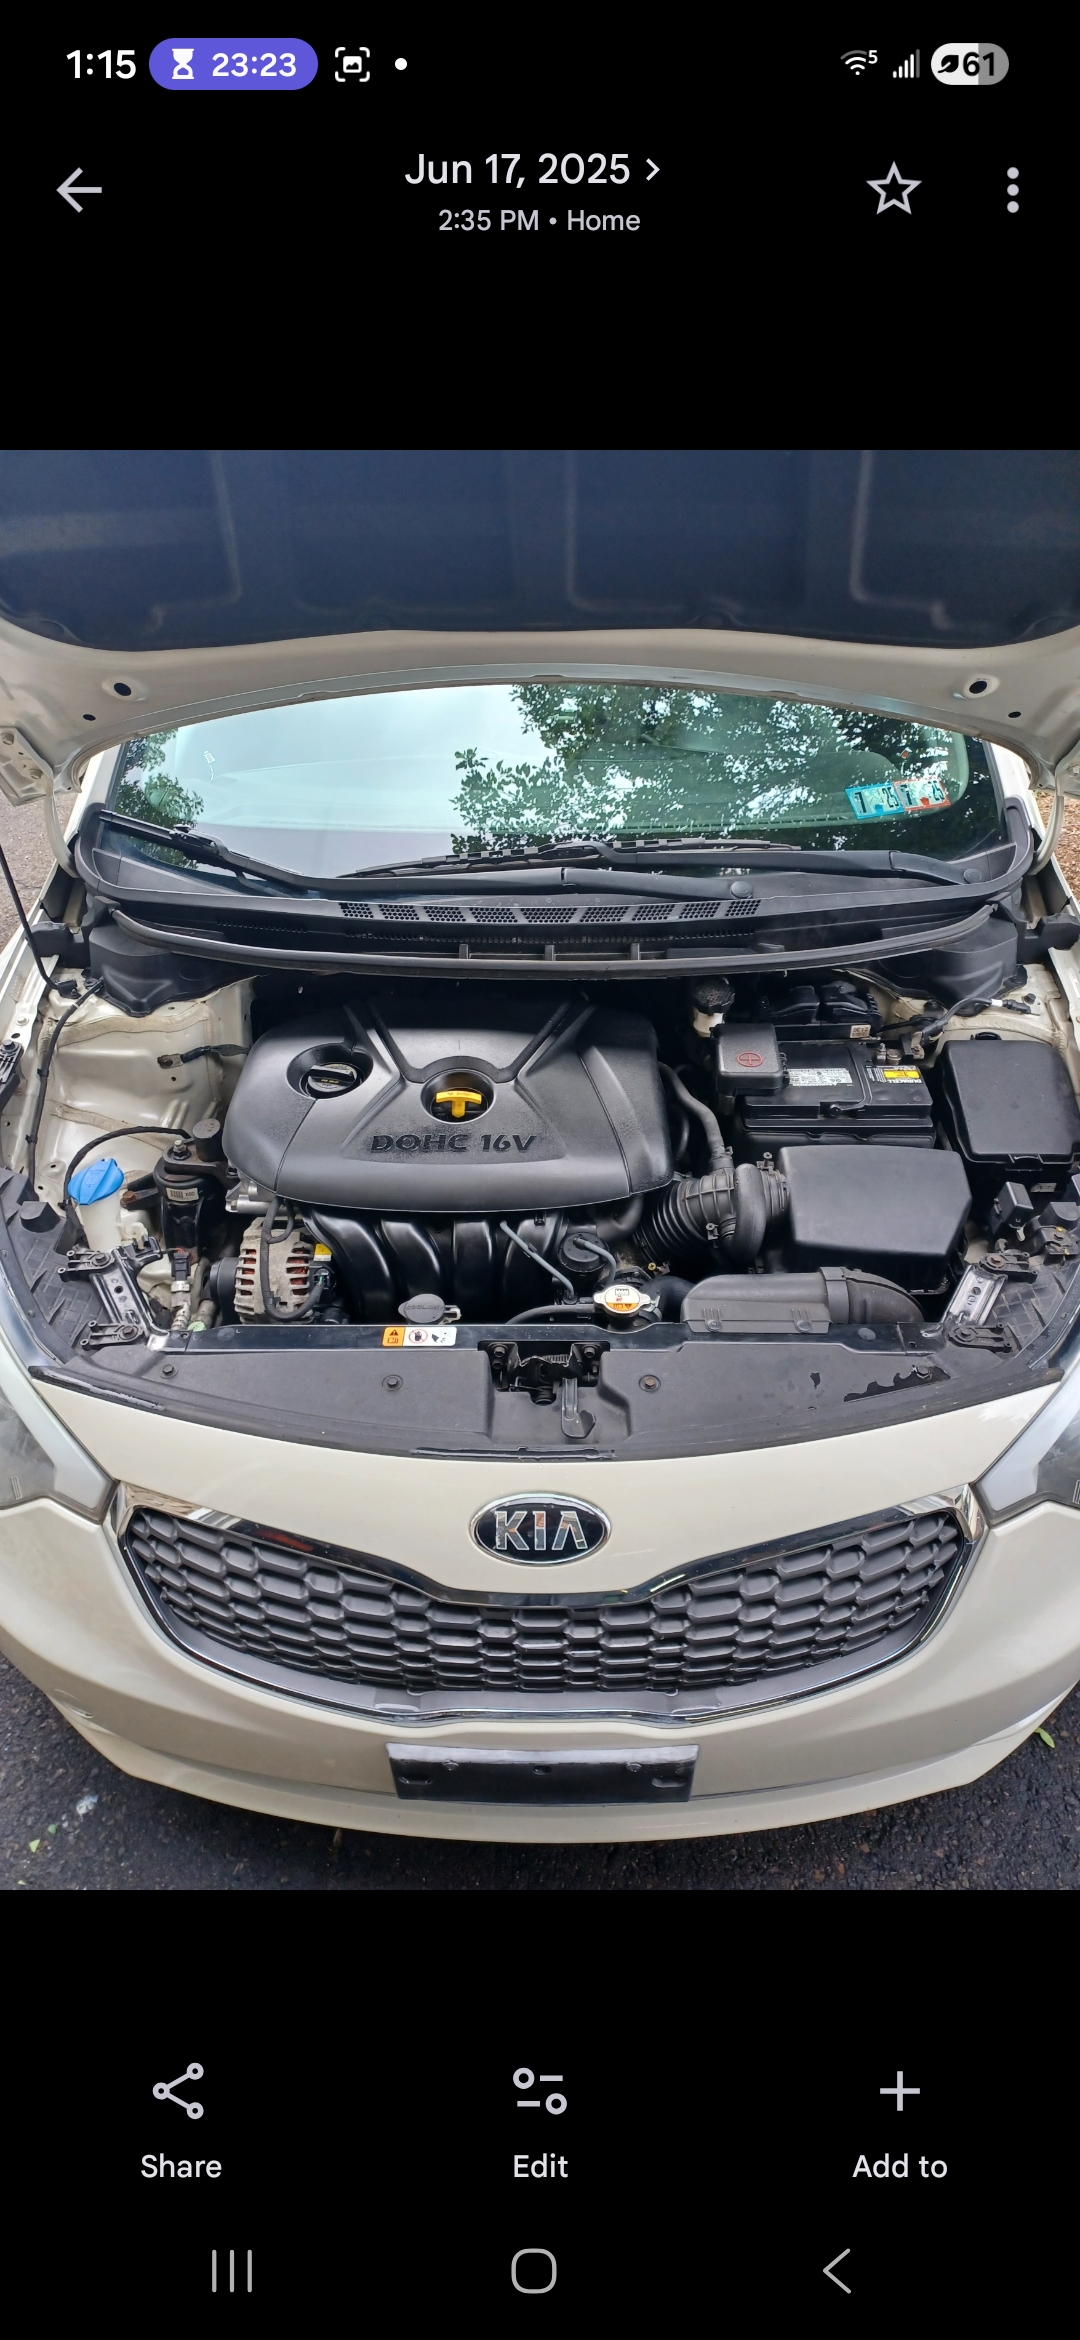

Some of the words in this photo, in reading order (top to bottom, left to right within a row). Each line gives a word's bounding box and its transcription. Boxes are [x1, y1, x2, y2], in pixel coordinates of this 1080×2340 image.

[882, 787, 899, 808] 25
[371, 1134, 468, 1152] DOHC
[480, 1134, 537, 1152] 16V
[494, 1510, 589, 1551] KIA
